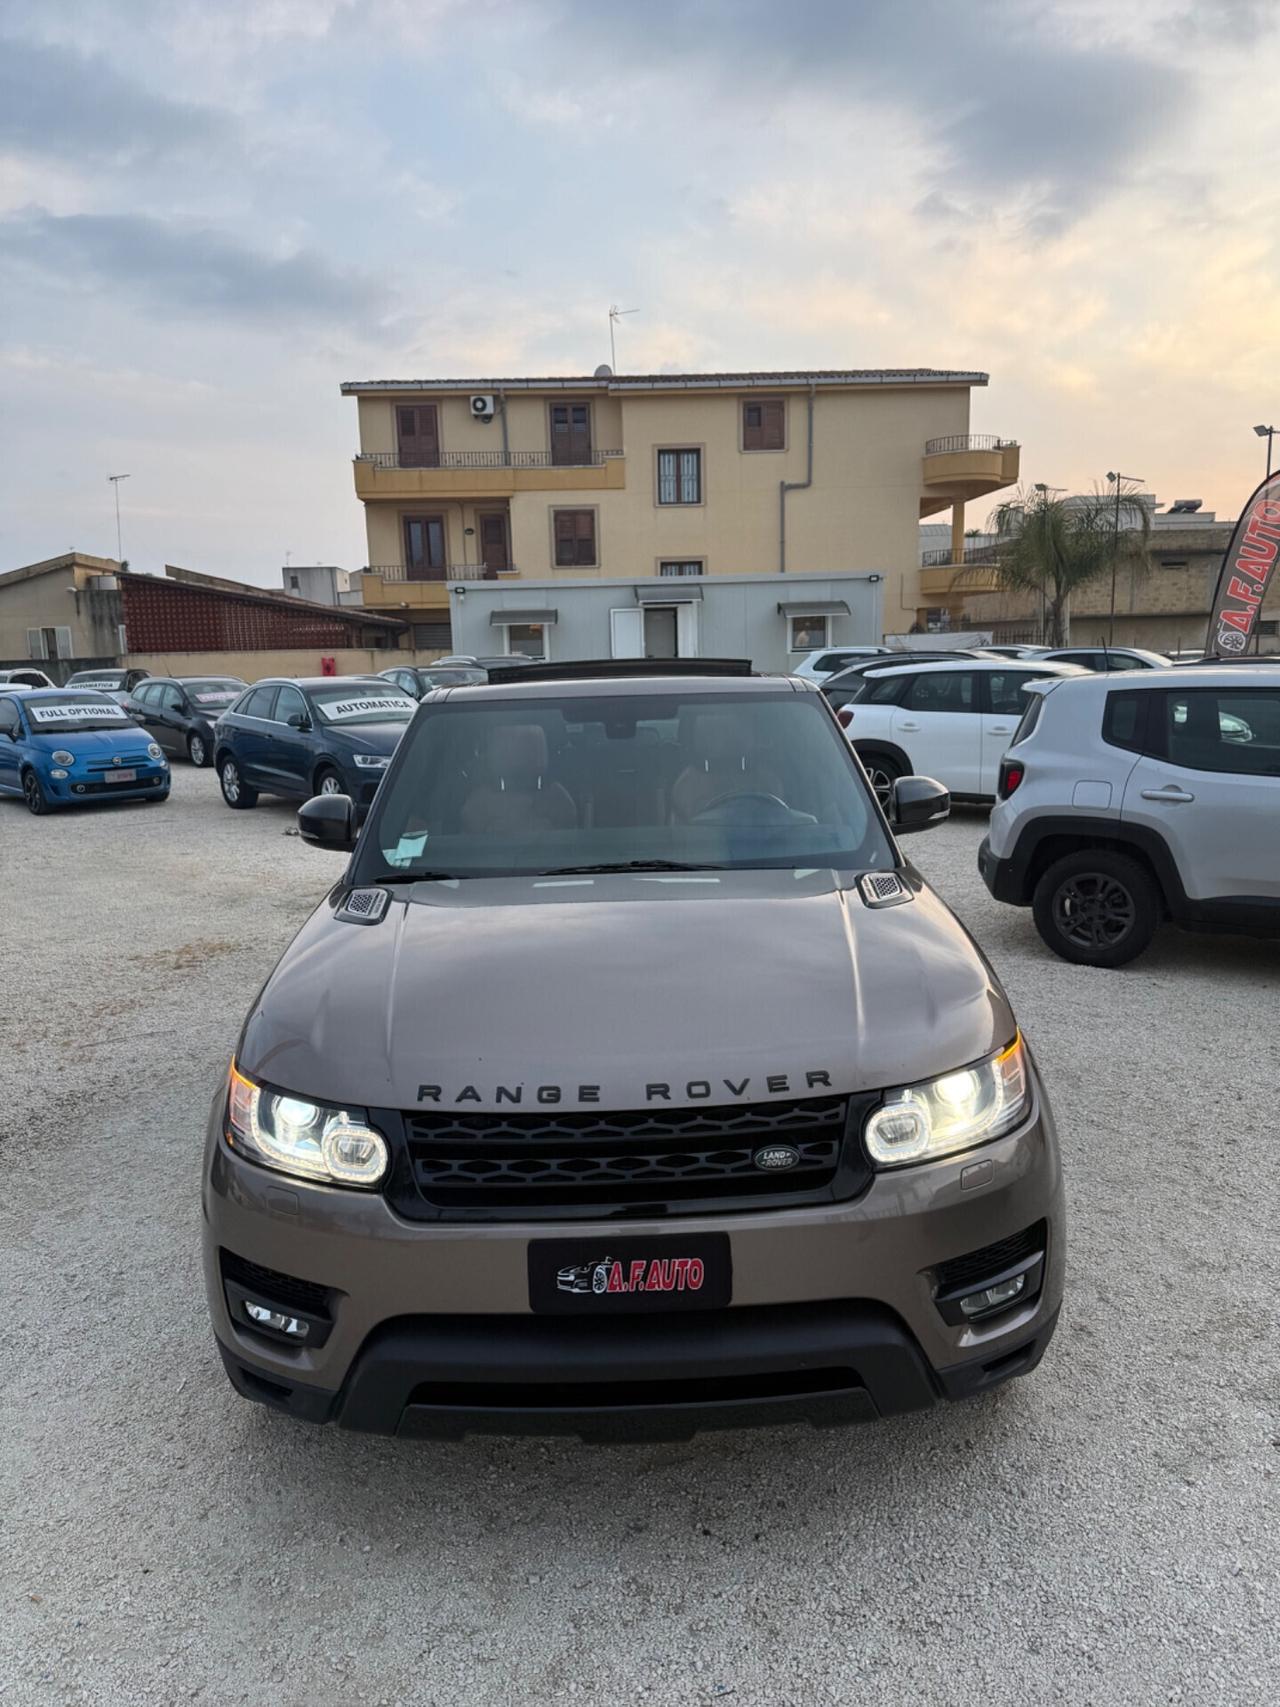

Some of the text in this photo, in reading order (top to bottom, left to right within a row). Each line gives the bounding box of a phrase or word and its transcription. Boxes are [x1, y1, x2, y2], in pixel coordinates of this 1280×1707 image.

[39, 707, 119, 719] FULL OPTIONAL
[335, 699, 412, 715] AUTOMATICA
[417, 1070, 832, 1104] RANGE ROVER
[606, 1258, 705, 1293] A.F.AUTO
